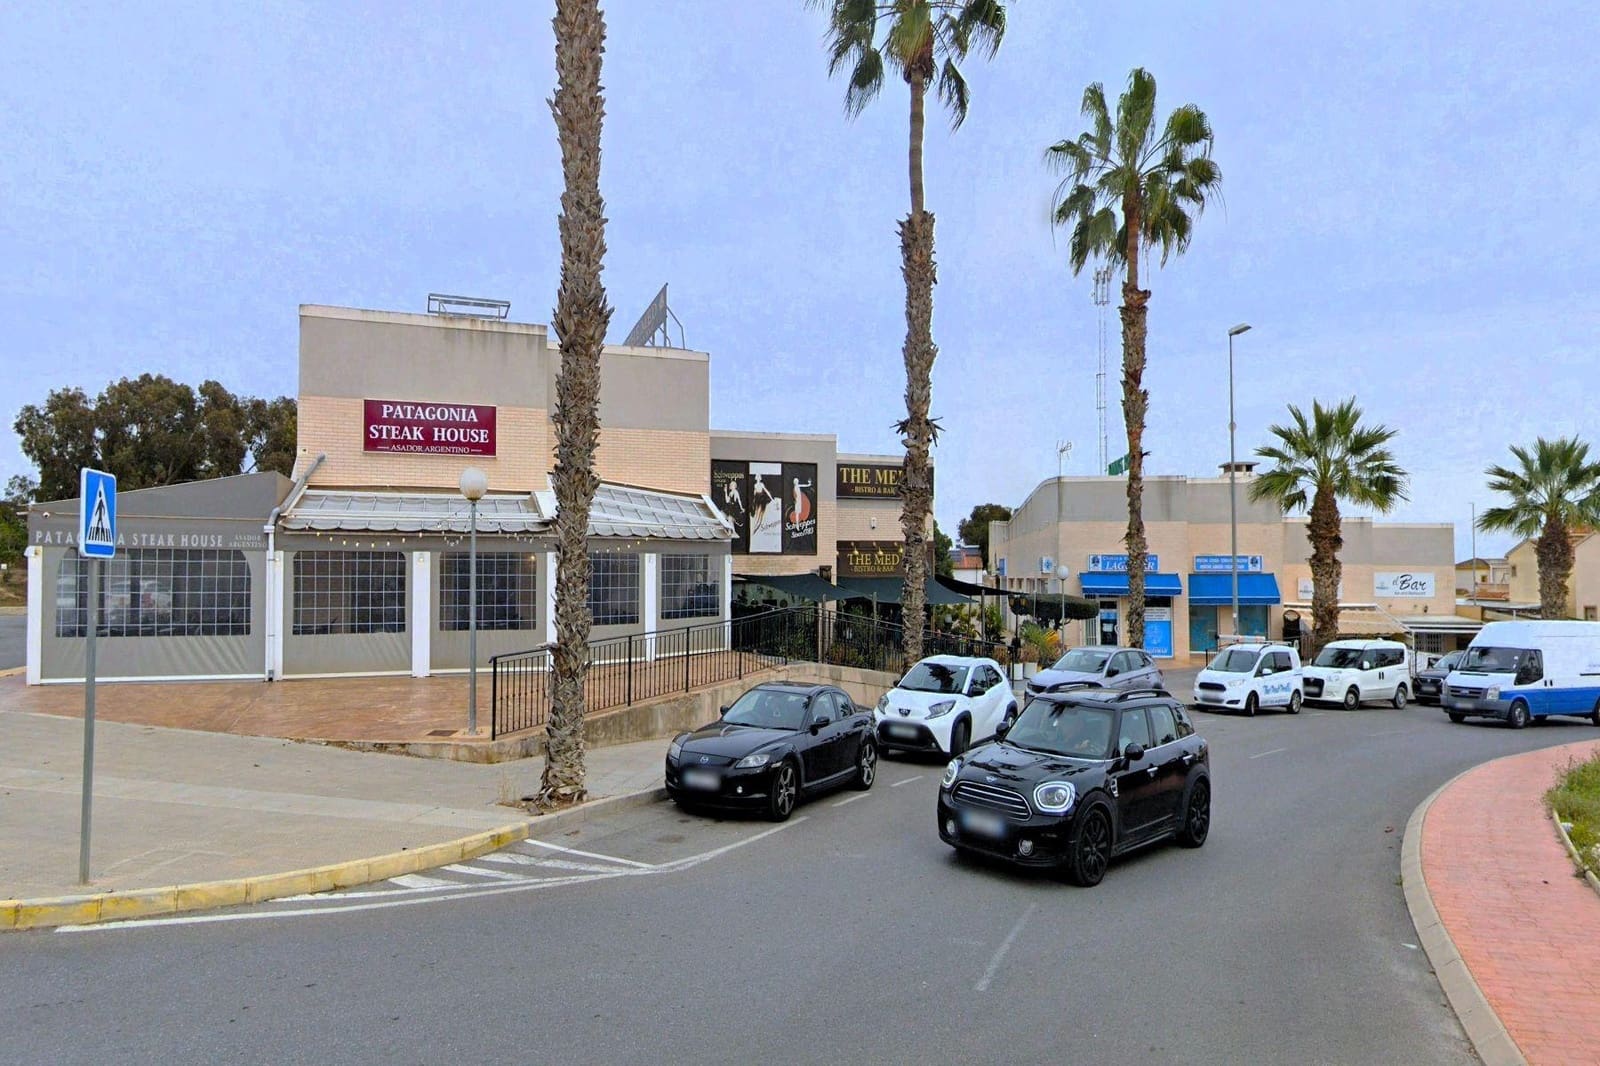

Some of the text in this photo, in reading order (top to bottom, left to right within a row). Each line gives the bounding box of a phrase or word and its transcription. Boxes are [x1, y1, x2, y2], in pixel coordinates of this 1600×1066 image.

[381, 404, 478, 422] PATAGONIA
[369, 424, 489, 443] STEAK HOUSE
[390, 444, 470, 454] ASADOR ARGENTINO
[840, 467, 871, 484] THE
[854, 486, 876, 494] BISTRO
[35, 530, 223, 547] PATAA STEAK HOUSE
[847, 553, 900, 566] THE MED
[1399, 573, 1427, 591] Bar
